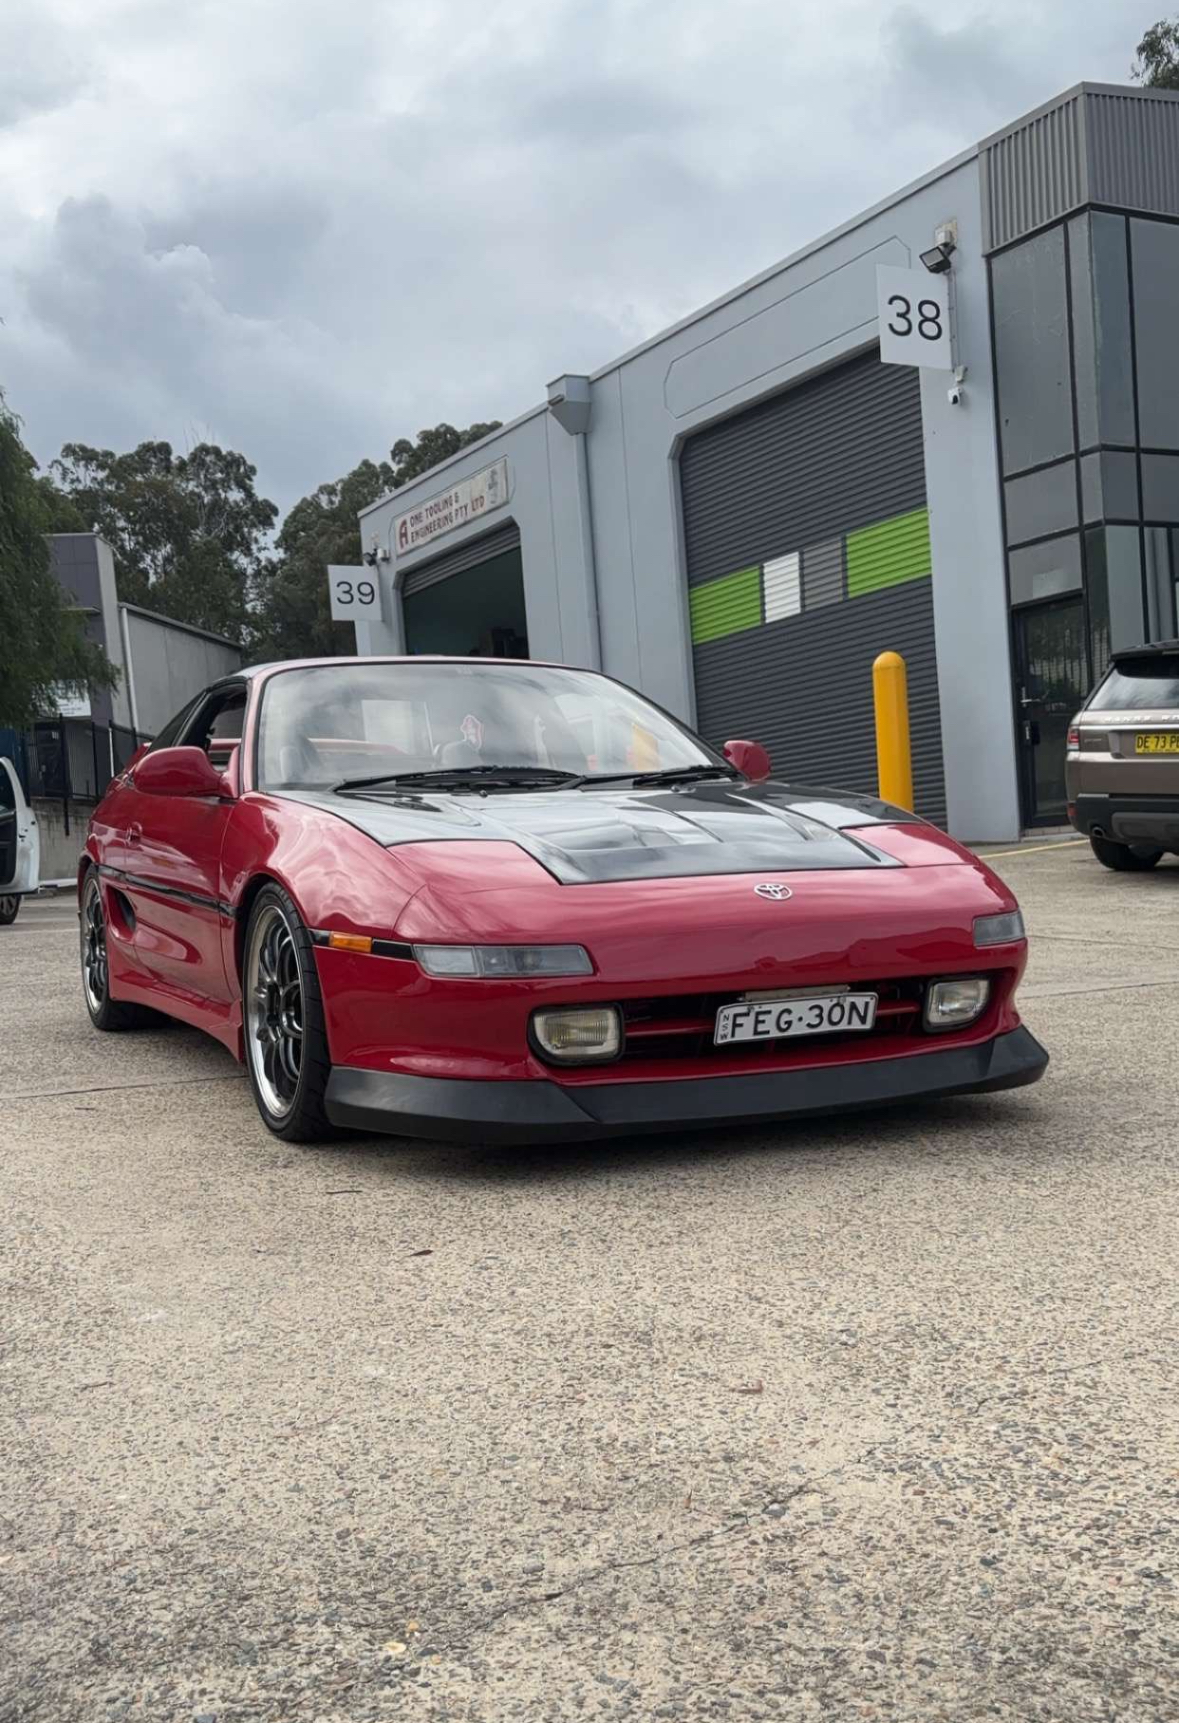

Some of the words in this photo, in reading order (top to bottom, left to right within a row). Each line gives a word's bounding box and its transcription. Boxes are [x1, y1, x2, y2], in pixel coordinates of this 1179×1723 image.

[888, 294, 942, 341] 38
[410, 511, 423, 527] ONE
[425, 495, 453, 519] TOOLING
[411, 511, 453, 543] ENGINEERING
[455, 503, 469, 520] PTY
[471, 495, 485, 512] LTD
[399, 519, 409, 549] A
[336, 581, 375, 605] 39
[1136, 735, 1150, 749] DE
[1154, 735, 1166, 749] 73
[720, 1013, 730, 1040] NSW
